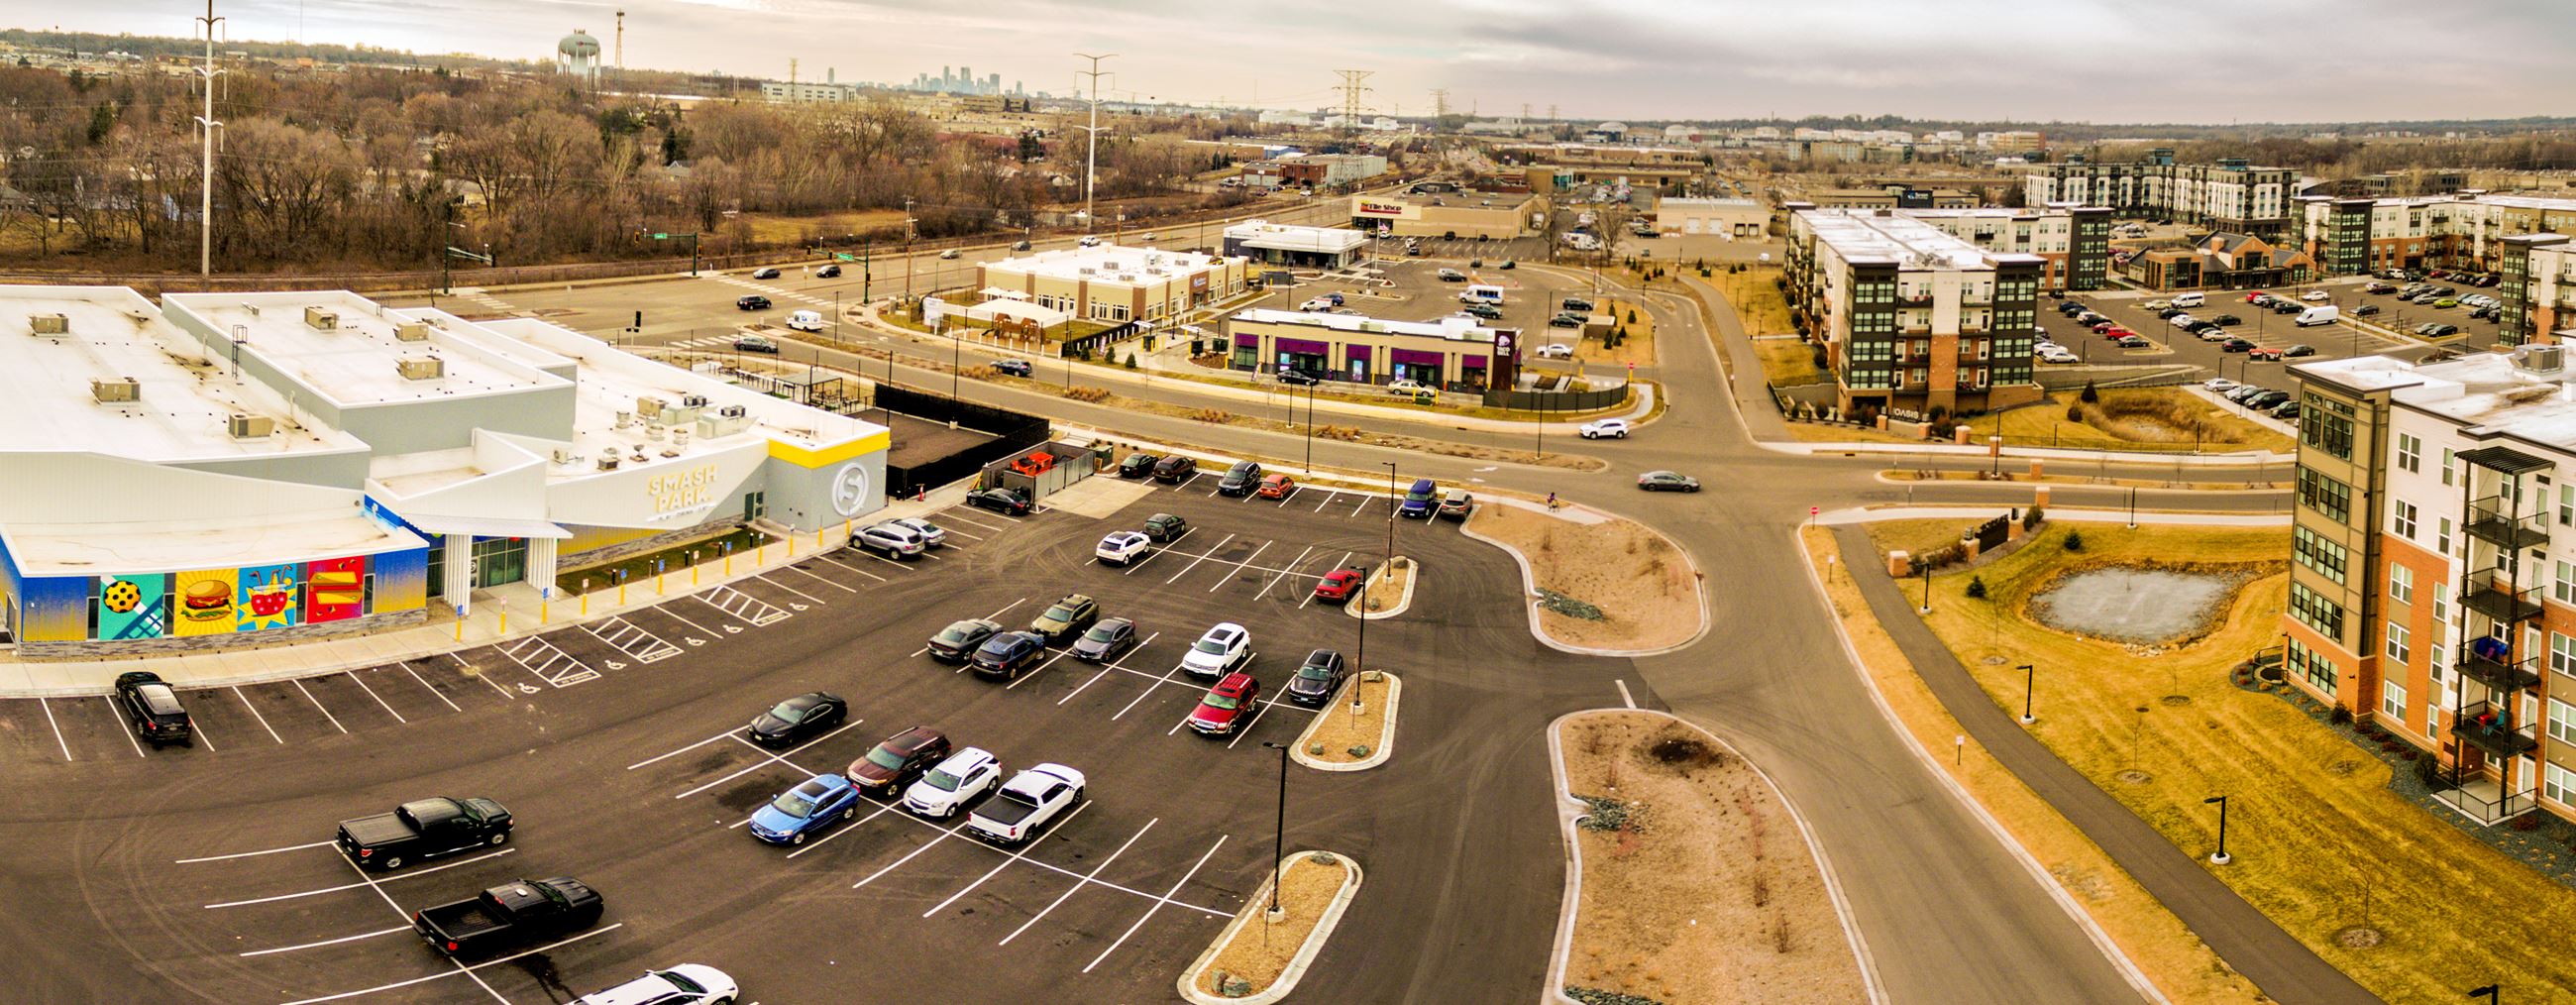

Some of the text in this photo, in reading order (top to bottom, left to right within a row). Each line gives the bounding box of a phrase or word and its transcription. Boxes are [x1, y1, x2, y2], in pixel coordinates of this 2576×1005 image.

[1894, 407, 1919, 419] OASIS
[648, 463, 716, 497] SMASH
[654, 484, 707, 513] PARK
